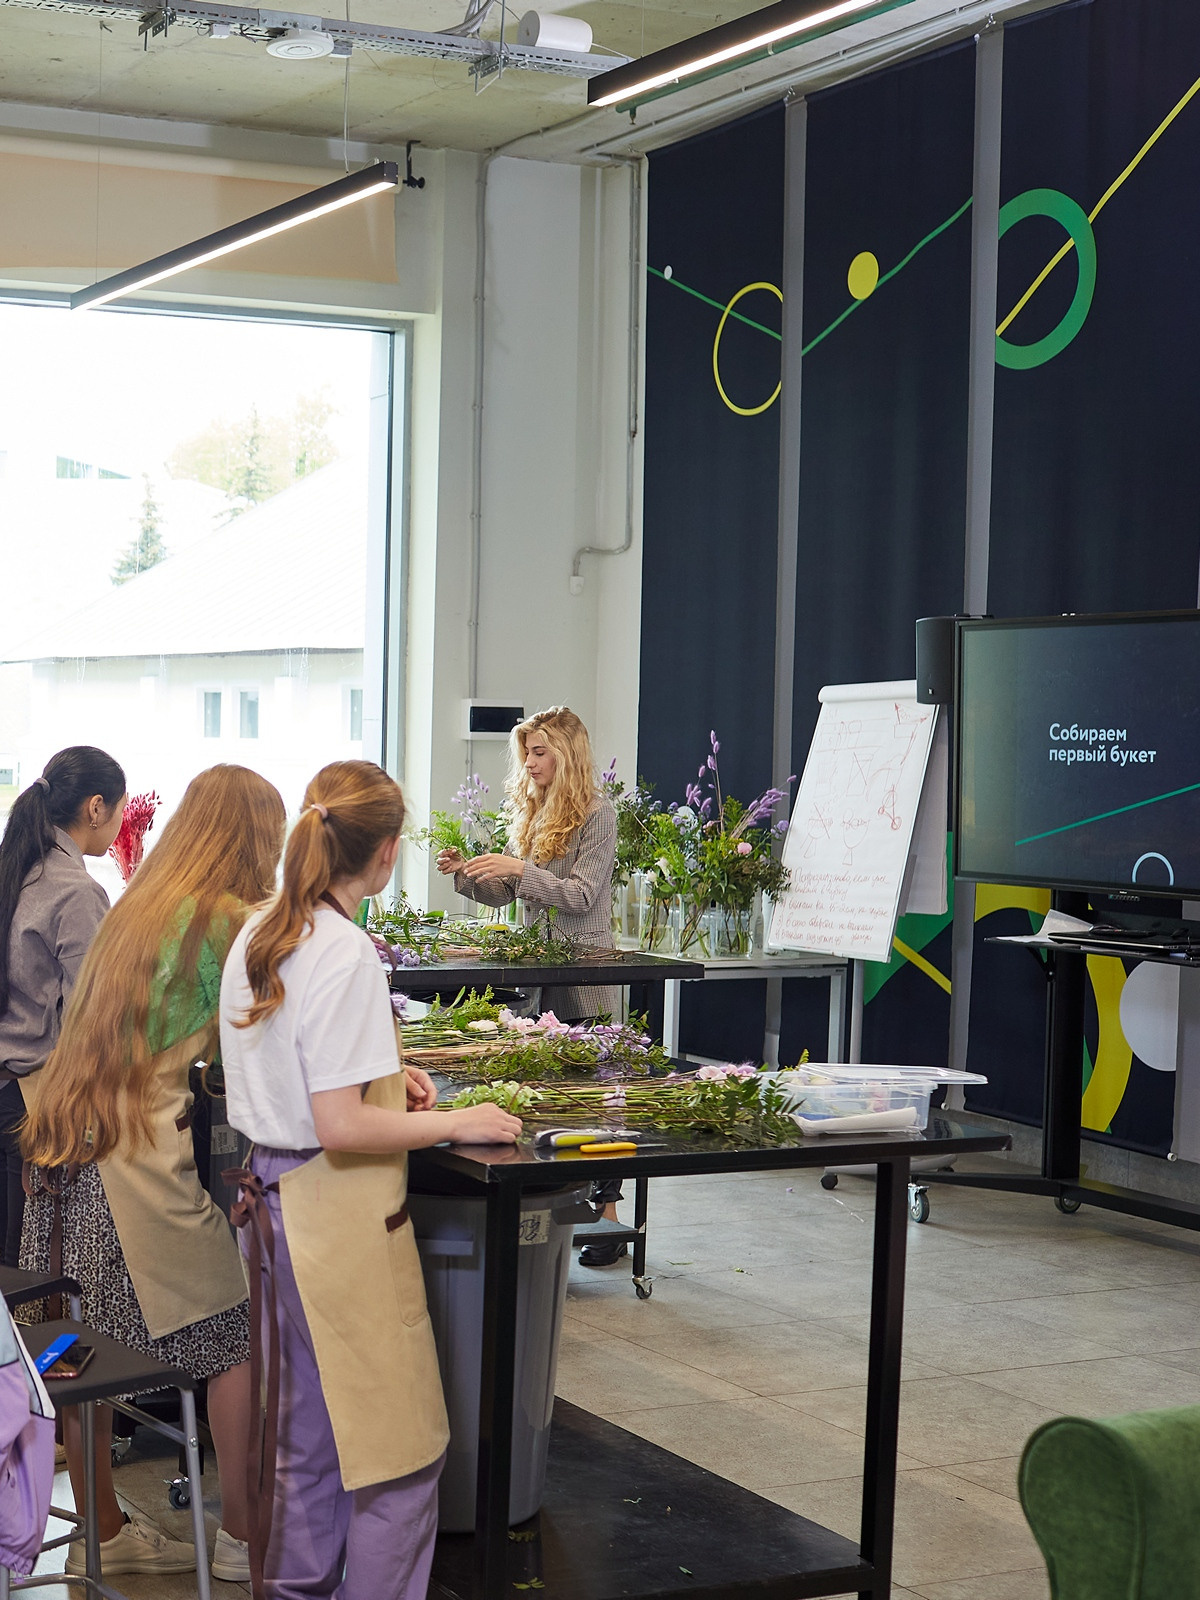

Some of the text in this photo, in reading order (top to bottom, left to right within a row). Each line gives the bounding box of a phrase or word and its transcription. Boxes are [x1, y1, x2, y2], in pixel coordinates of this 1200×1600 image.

[1049, 722, 1127, 745] Собираем
[1049, 744, 1157, 767] первый букет
